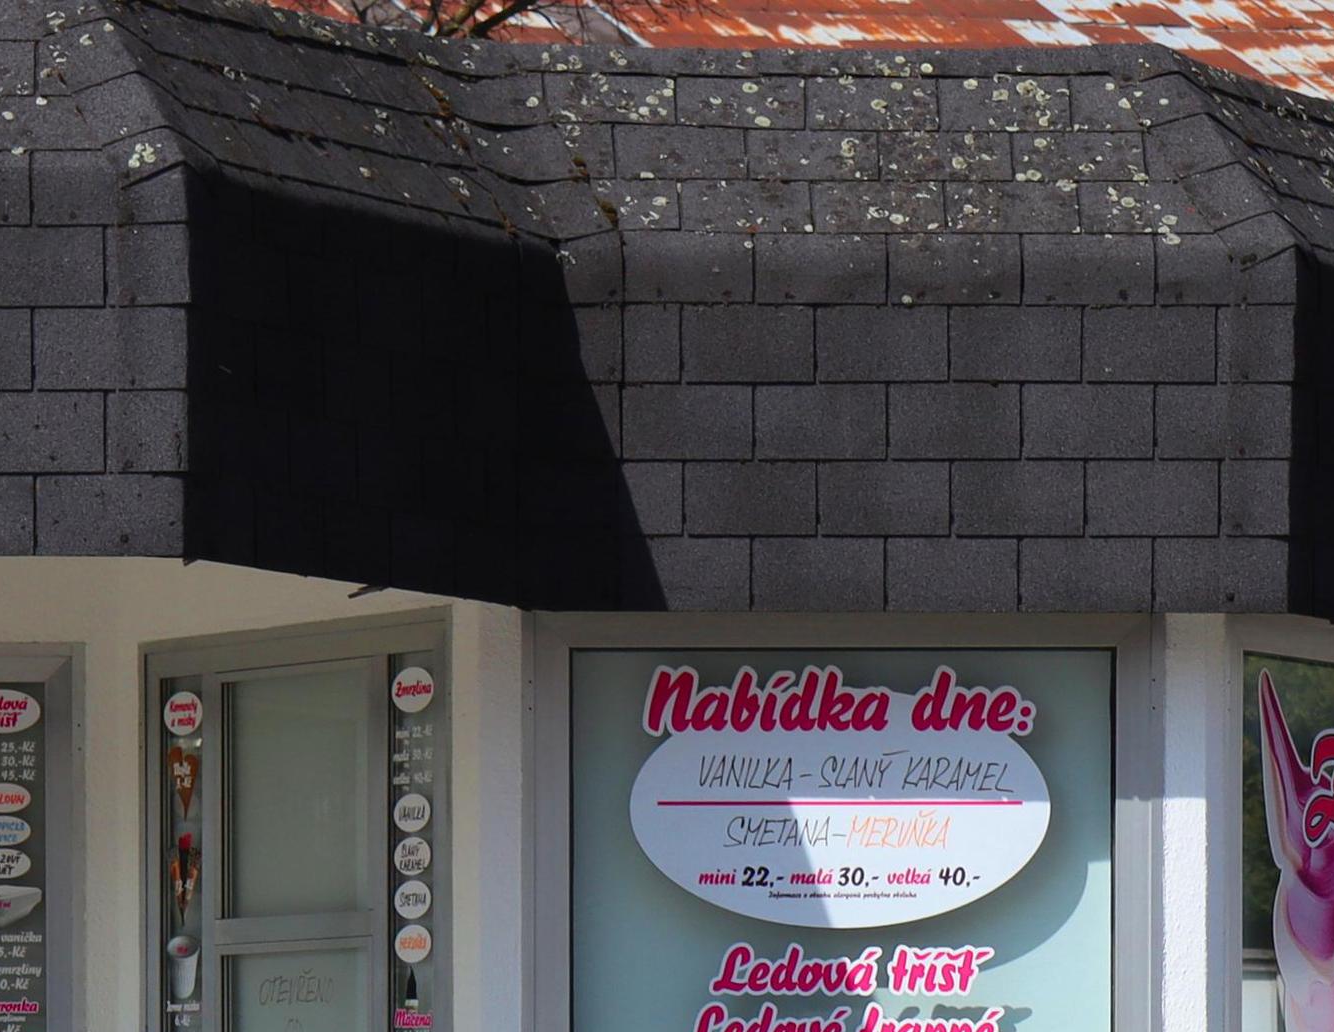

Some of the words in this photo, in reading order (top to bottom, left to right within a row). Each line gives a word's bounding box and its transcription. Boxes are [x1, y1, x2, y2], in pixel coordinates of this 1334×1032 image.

[646, 669, 890, 734] Nabídka
[911, 671, 1034, 734] dne:
[699, 755, 793, 791] VANILKA
[818, 750, 908, 789] SLANÝ
[902, 755, 1014, 793] KARAMEL
[699, 866, 736, 886] mini
[741, 866, 784, 888] 22,-
[790, 866, 833, 886] malá
[838, 866, 879, 888] 30,-
[887, 866, 932, 886] velká
[938, 866, 981, 888] 40,-
[715, 945, 876, 994] Ledová
[890, 947, 992, 993] tříšť
